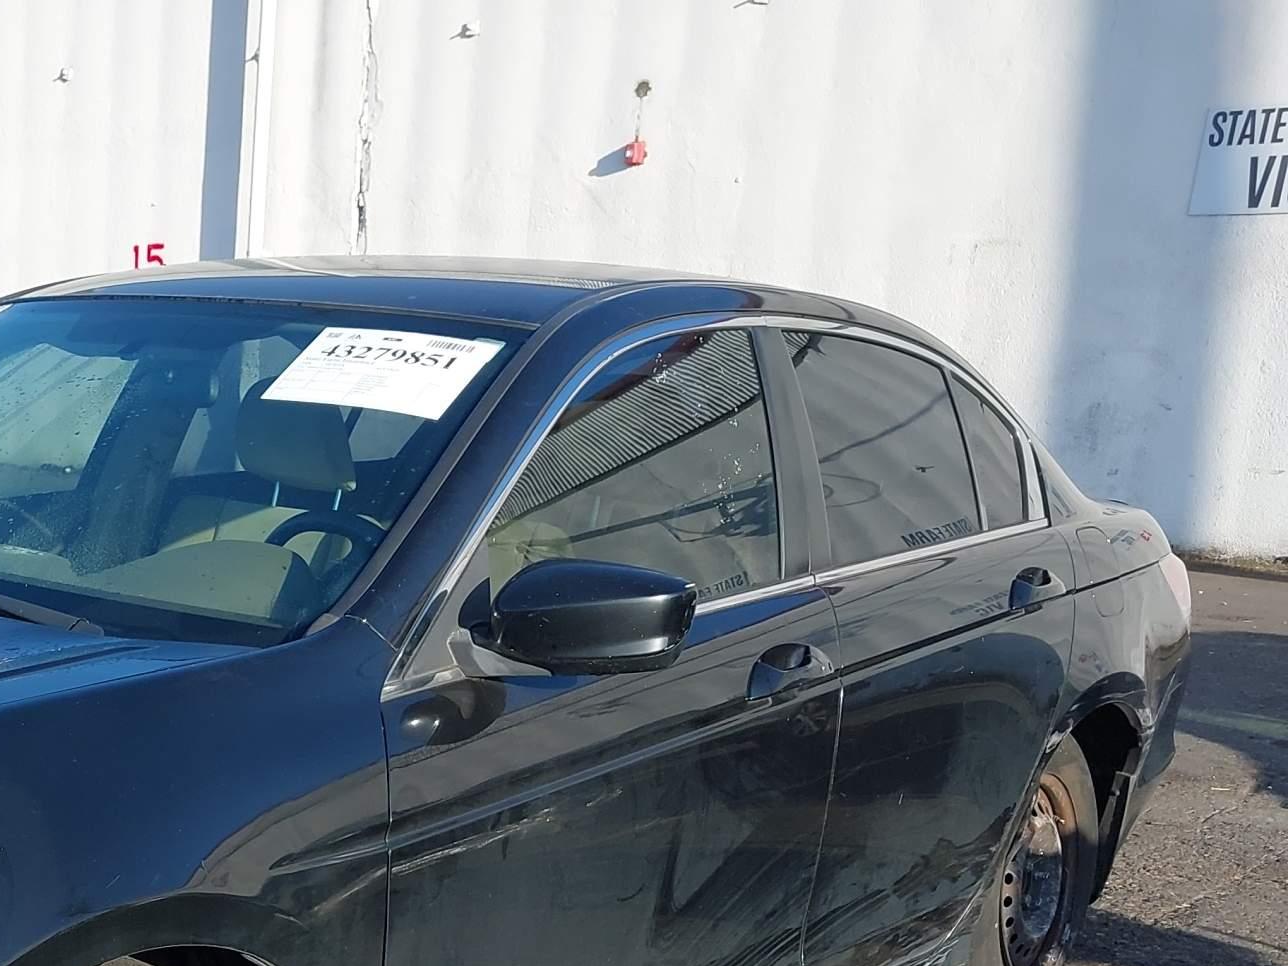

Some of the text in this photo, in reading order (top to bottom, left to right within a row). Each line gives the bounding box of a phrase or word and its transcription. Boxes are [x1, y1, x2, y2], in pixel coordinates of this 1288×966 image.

[1208, 107, 1288, 147] STATE
[1247, 154, 1288, 208] VI
[133, 243, 165, 270] 15
[320, 344, 458, 370] 43279851
